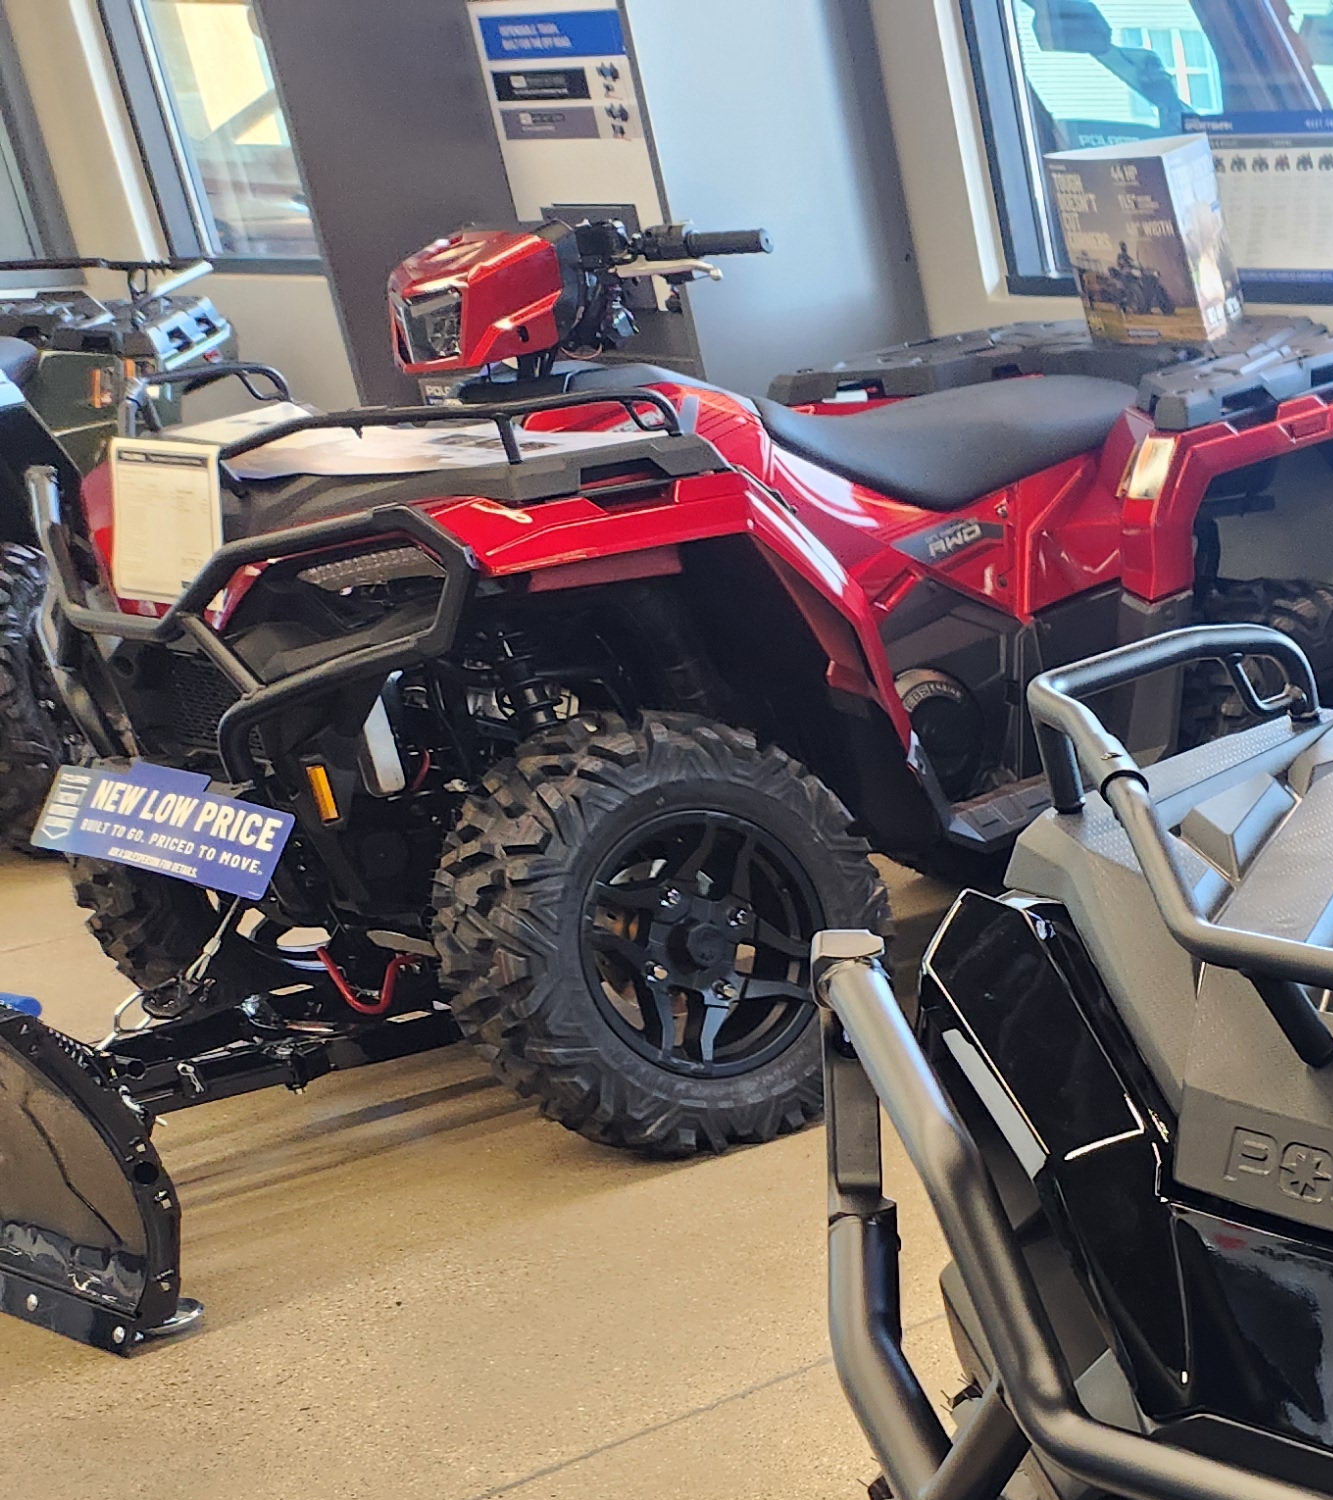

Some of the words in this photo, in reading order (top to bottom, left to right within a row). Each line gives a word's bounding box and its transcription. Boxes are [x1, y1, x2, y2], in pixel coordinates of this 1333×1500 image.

[80, 818, 111, 834] BUILT
[111, 824, 128, 840] TO
[149, 832, 194, 856] PRICED
[198, 844, 216, 862] TO
[90, 779, 147, 815] NEW
[139, 790, 200, 828] LOW
[194, 801, 283, 852] PRICE
